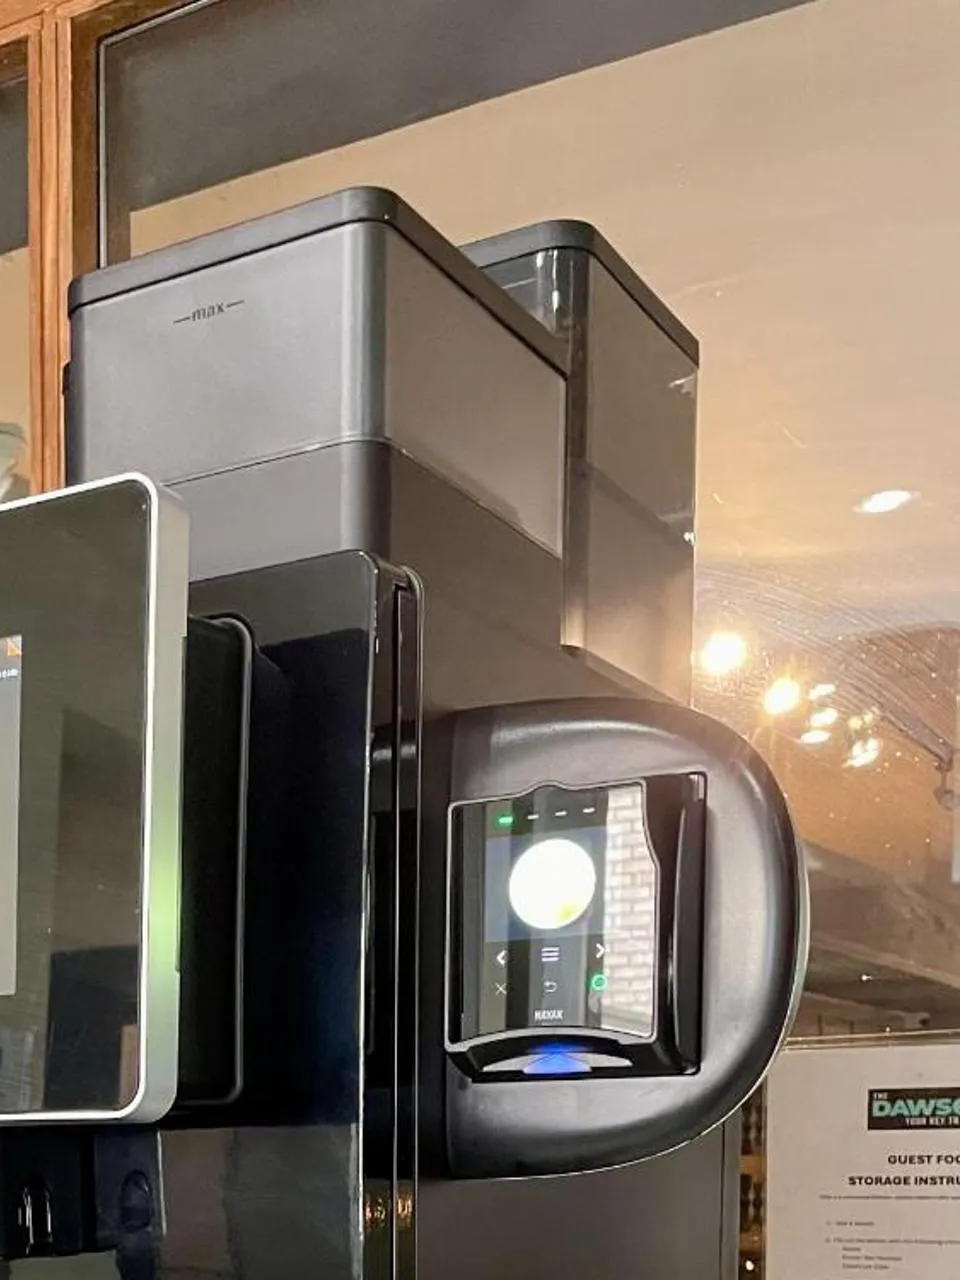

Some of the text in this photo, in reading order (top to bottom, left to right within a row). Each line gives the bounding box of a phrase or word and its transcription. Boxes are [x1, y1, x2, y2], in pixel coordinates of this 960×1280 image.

[192, 302, 224, 322] max
[887, 1154, 933, 1165] GUEST
[848, 1175, 911, 1186] STORAGE
